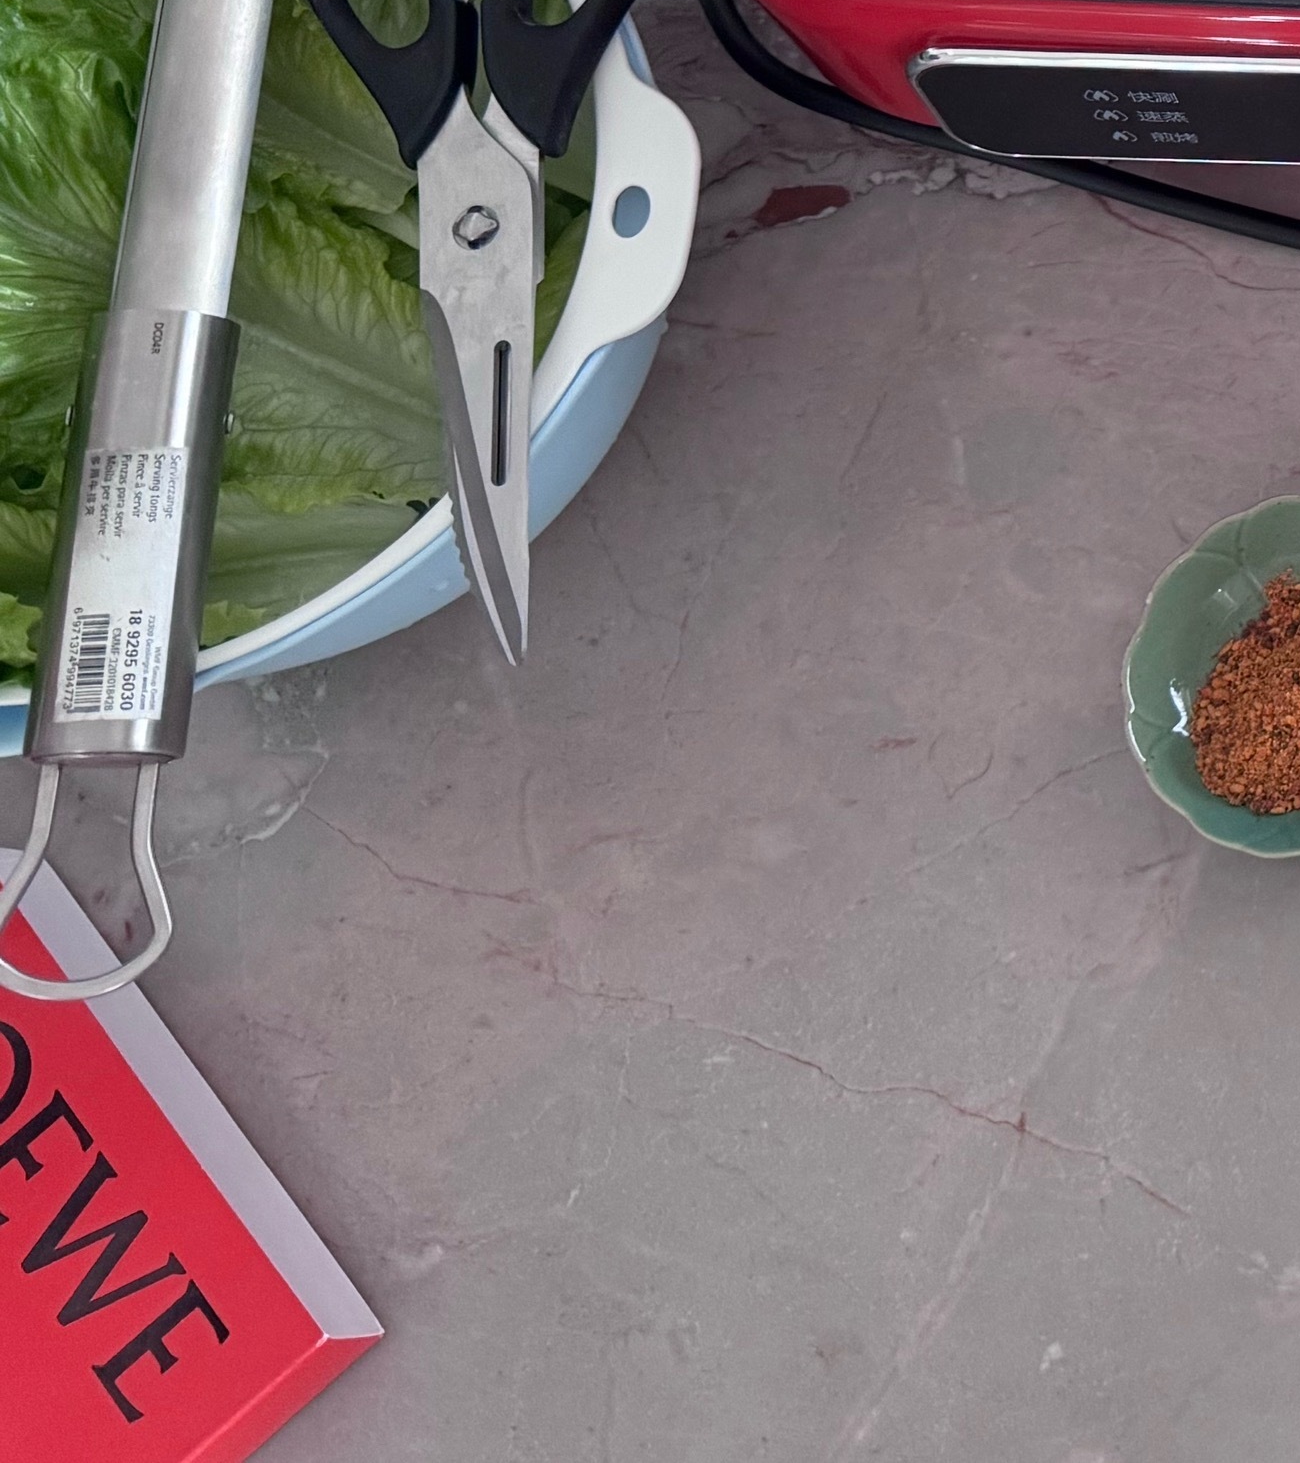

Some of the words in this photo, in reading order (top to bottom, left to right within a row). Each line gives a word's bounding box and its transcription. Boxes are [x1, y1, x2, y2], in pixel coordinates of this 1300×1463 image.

[118, 455, 132, 485] Pinzas
[135, 454, 148, 480] Pince
[148, 454, 166, 492] Serving
[98, 485, 111, 500] per
[113, 488, 126, 508] para
[162, 455, 182, 519] Servierzange
[131, 491, 145, 518] servir
[145, 495, 160, 523] tongs
[96, 503, 110, 536] servire
[112, 512, 127, 539] servir
[128, 608, 142, 625] 18
[123, 629, 140, 668] 9295
[119, 672, 135, 711] 6030
[0, 1021, 230, 1424] EWE
